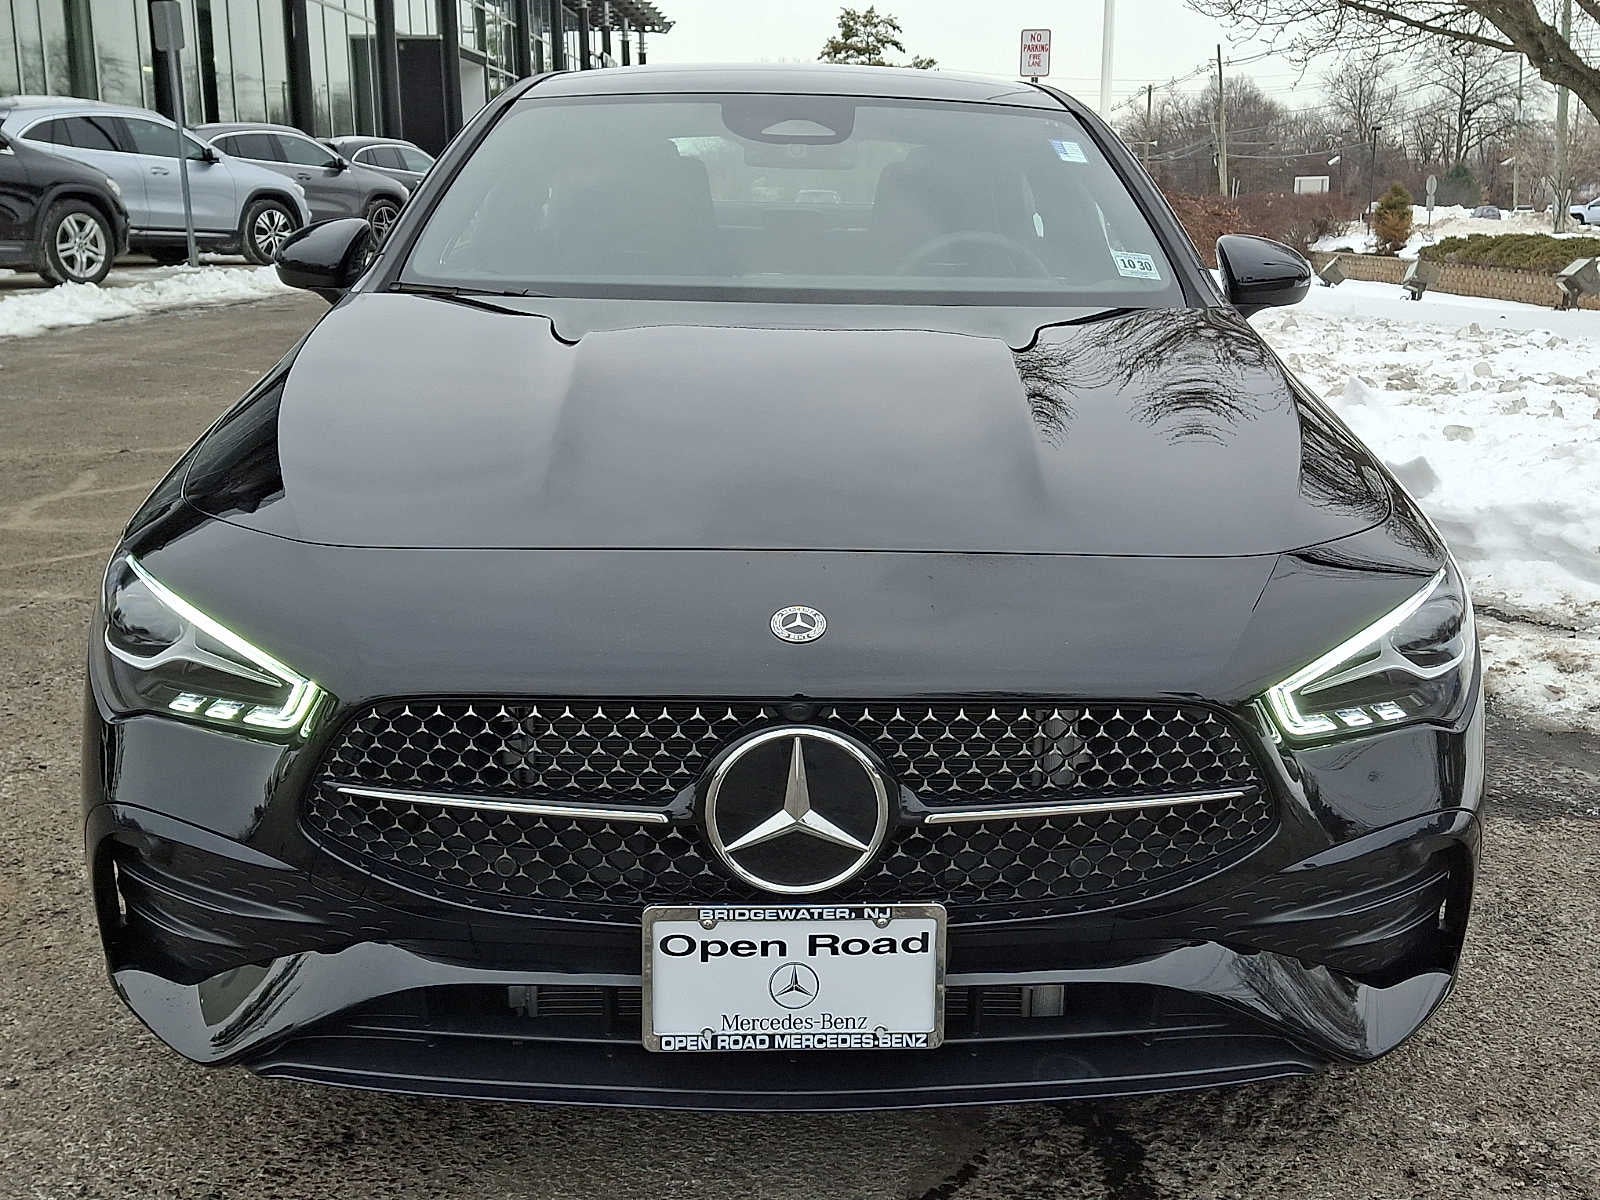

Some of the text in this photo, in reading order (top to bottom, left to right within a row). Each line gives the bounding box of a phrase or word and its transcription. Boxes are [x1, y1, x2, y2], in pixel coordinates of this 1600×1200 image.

[1030, 33, 1042, 42] NO
[1023, 44, 1048, 52] PARKING
[1120, 258, 1152, 271] 10 30
[699, 907, 891, 920] BRIDGEWATER, NJ
[659, 931, 930, 962] Open Road
[720, 1013, 868, 1031] Mercedes-Benz
[661, 1034, 713, 1050] OPEN
[717, 1034, 770, 1050] ROAD
